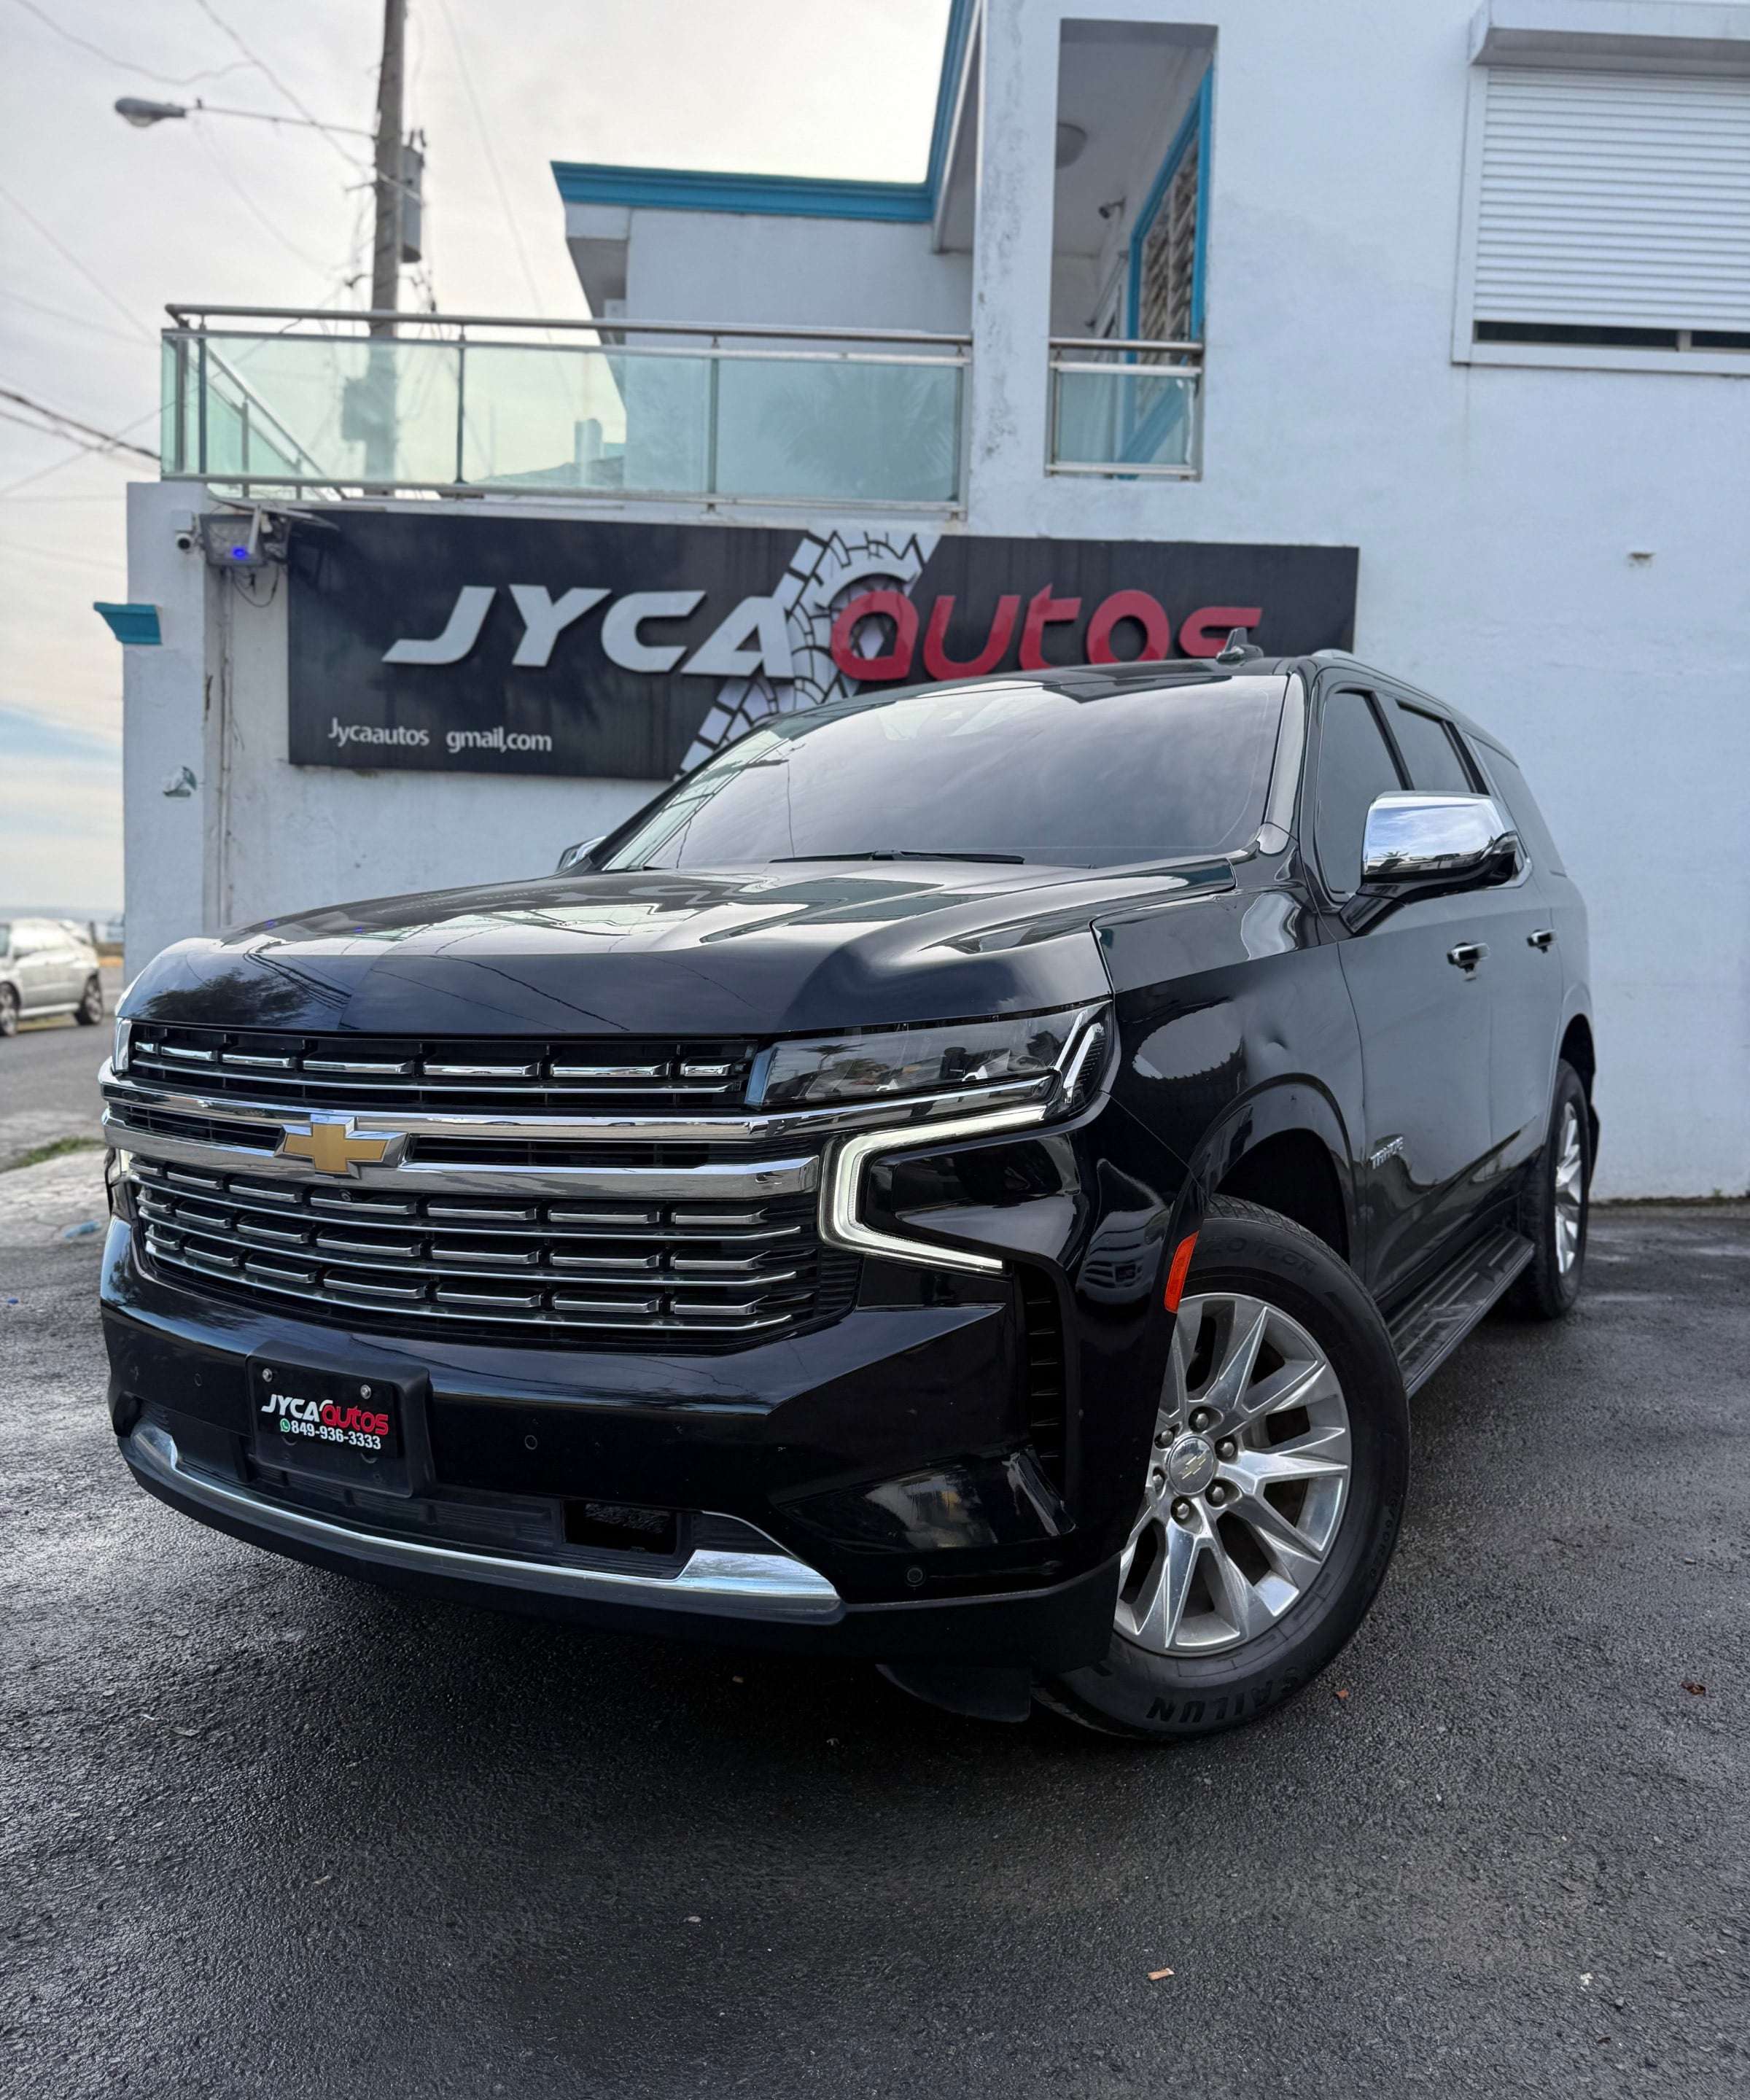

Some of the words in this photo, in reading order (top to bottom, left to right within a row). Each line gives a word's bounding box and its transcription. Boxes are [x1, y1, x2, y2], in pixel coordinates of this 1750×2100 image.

[381, 586, 794, 678] JYCA
[328, 717, 429, 747] Jycaautos
[261, 1393, 320, 1422] JYCA
[321, 1404, 389, 1435] autos
[291, 1420, 381, 1450] 849-936-3333
